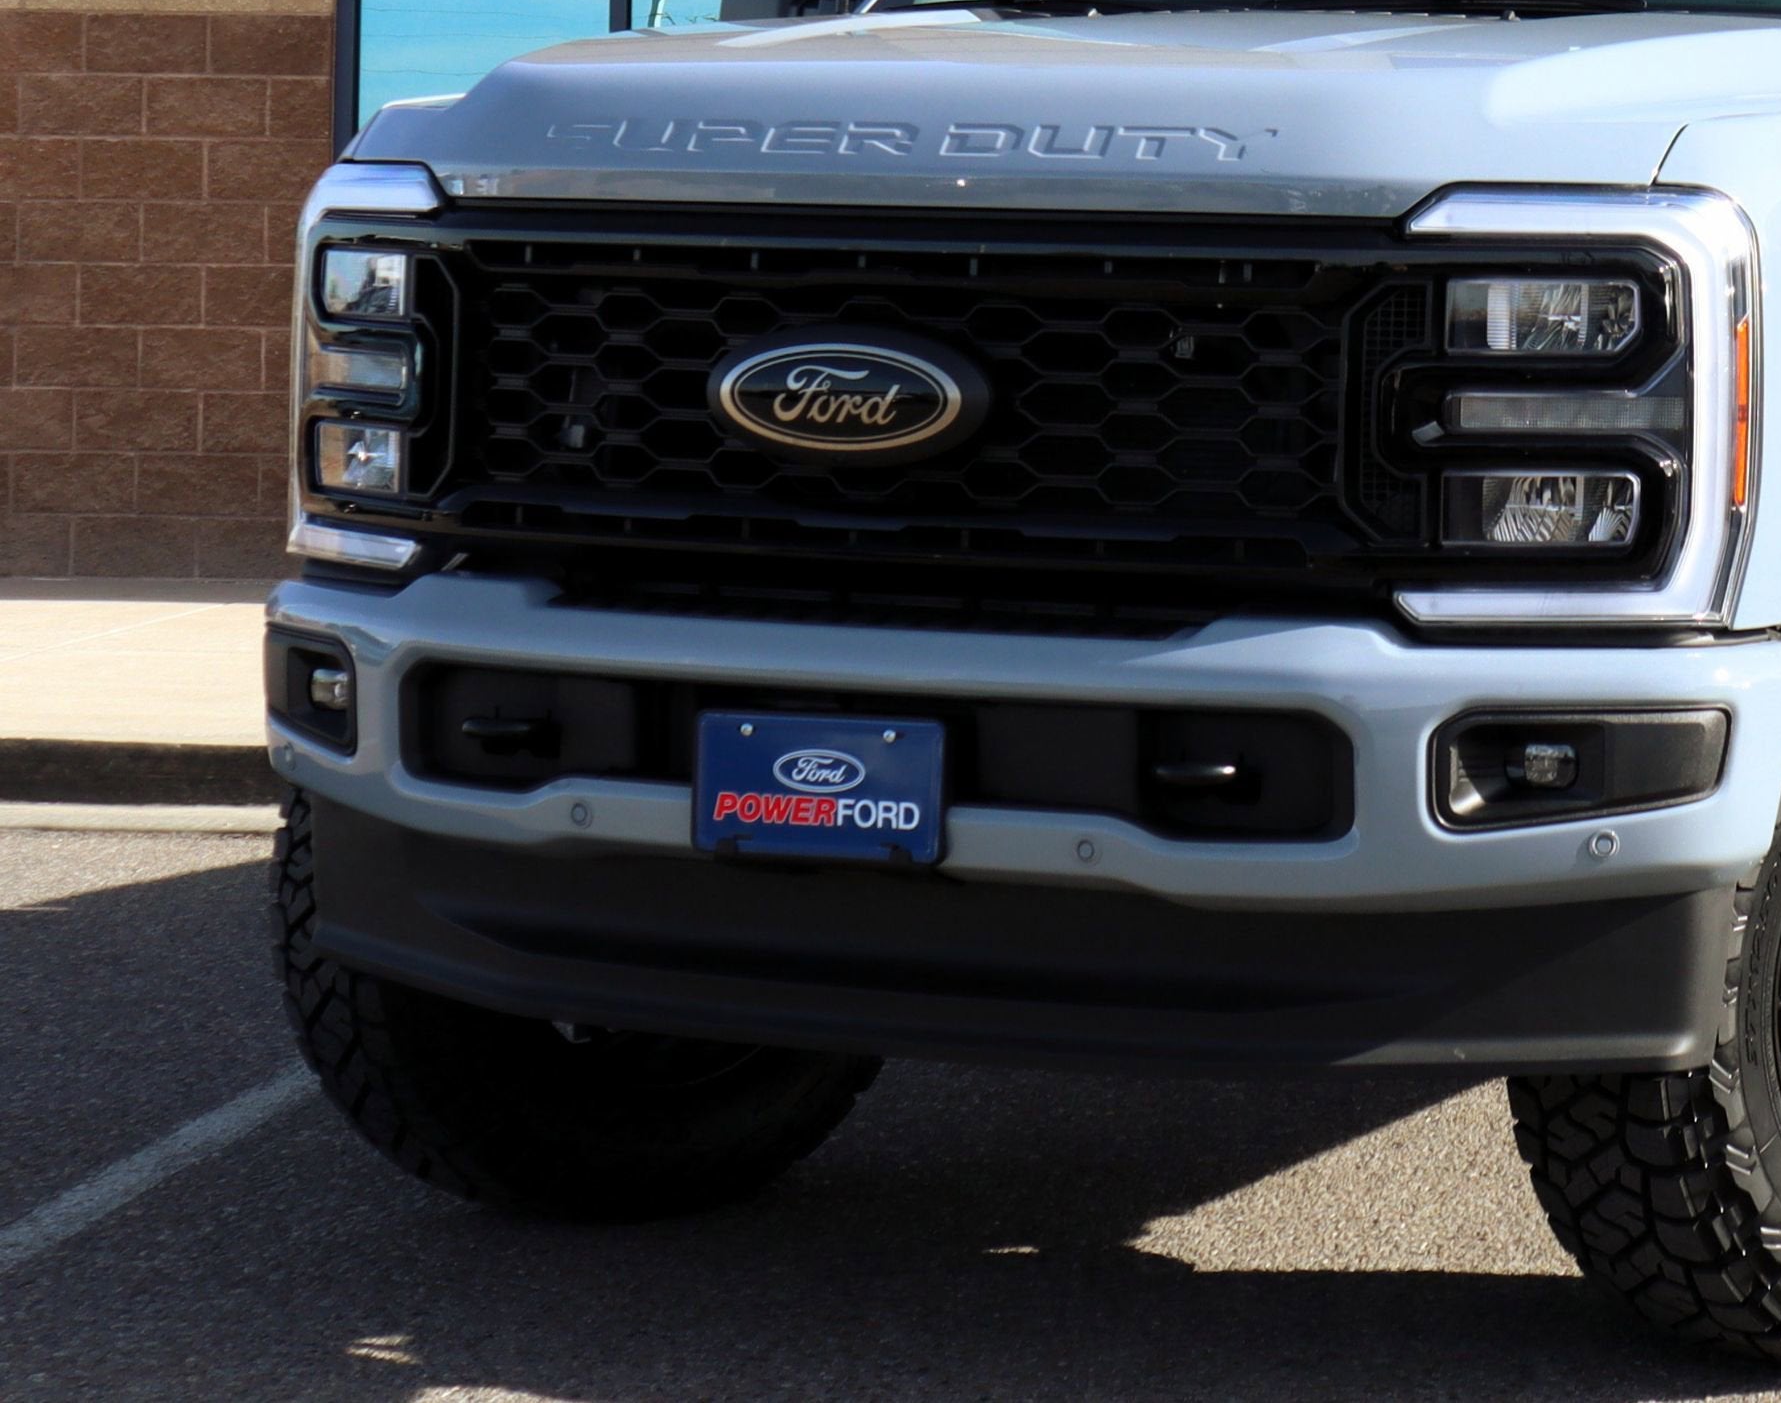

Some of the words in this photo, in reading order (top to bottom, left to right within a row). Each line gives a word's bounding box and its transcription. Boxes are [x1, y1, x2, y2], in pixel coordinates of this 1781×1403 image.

[546, 117, 921, 157] SUPER
[938, 124, 1279, 162] DUTY
[772, 365, 902, 426] Ford
[791, 756, 851, 784] Ford
[713, 792, 921, 831] POWERFORD
